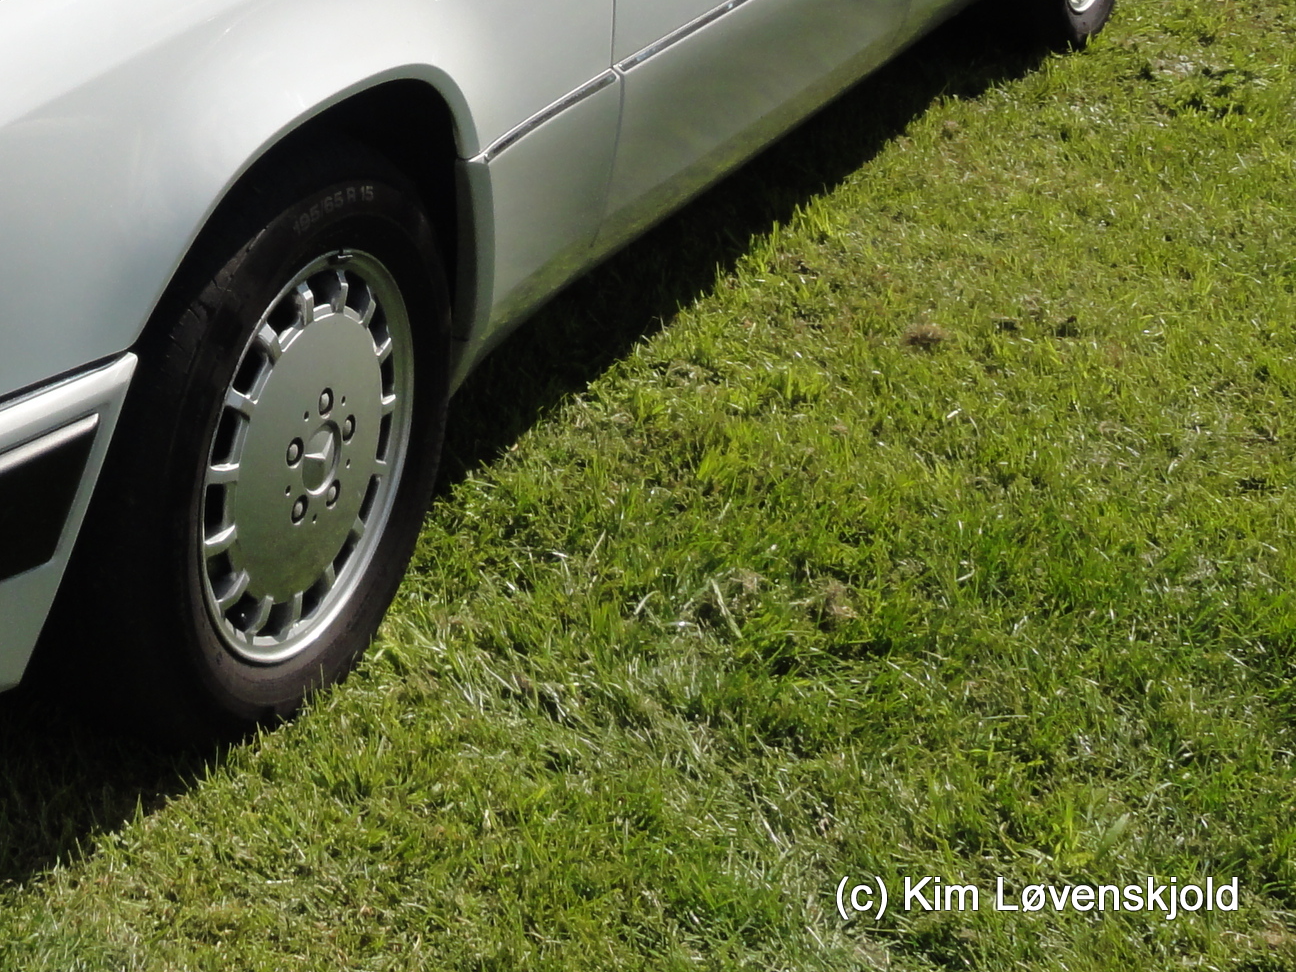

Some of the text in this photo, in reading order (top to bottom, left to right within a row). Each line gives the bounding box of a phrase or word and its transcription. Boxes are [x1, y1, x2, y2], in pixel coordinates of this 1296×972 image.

[292, 185, 375, 235] 195/65 R 15
